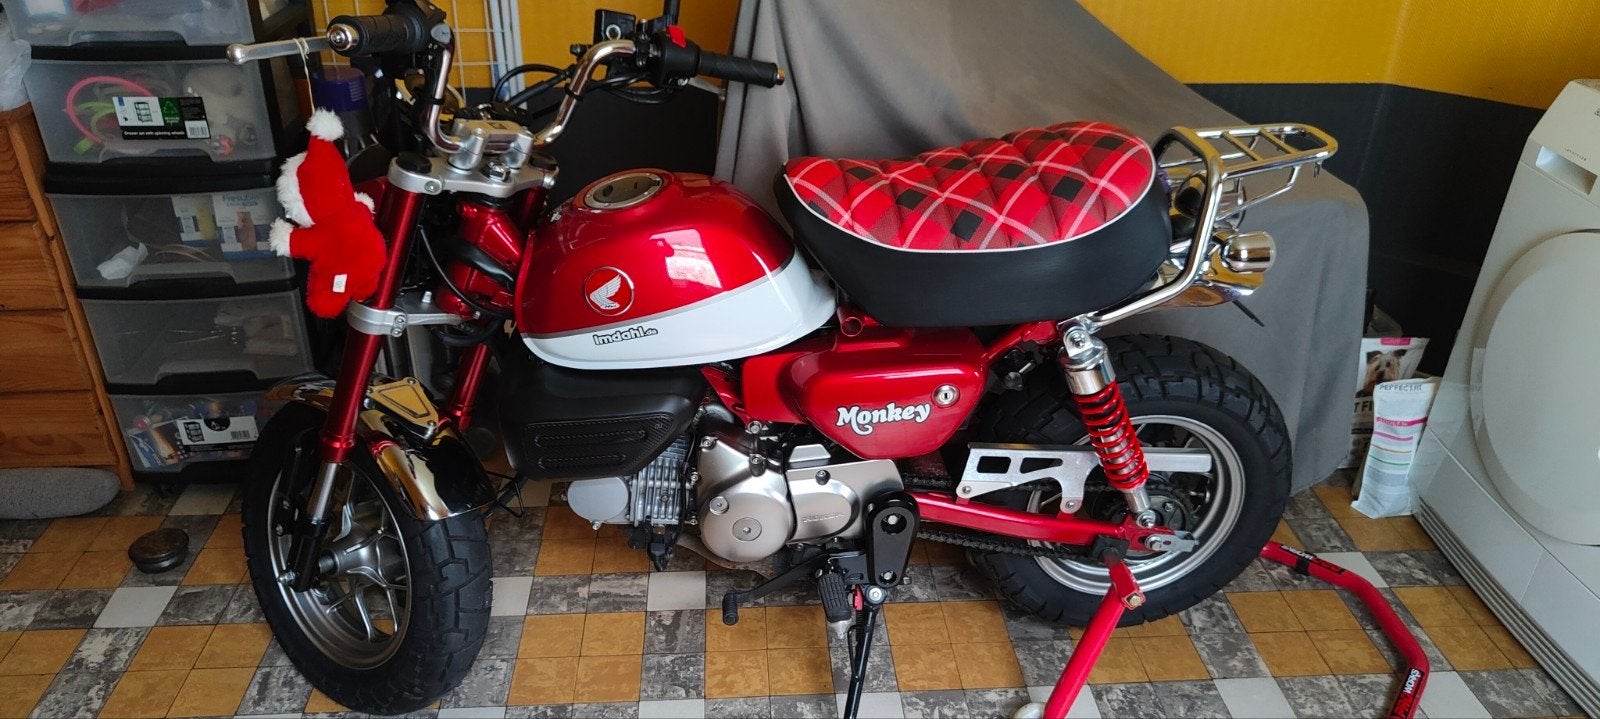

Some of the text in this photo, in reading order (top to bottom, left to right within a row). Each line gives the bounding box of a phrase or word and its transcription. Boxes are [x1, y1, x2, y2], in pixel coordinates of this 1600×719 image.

[592, 325, 658, 346] Imdahl.de
[836, 402, 931, 436] Monkey
[1402, 668, 1422, 694] WORKS
